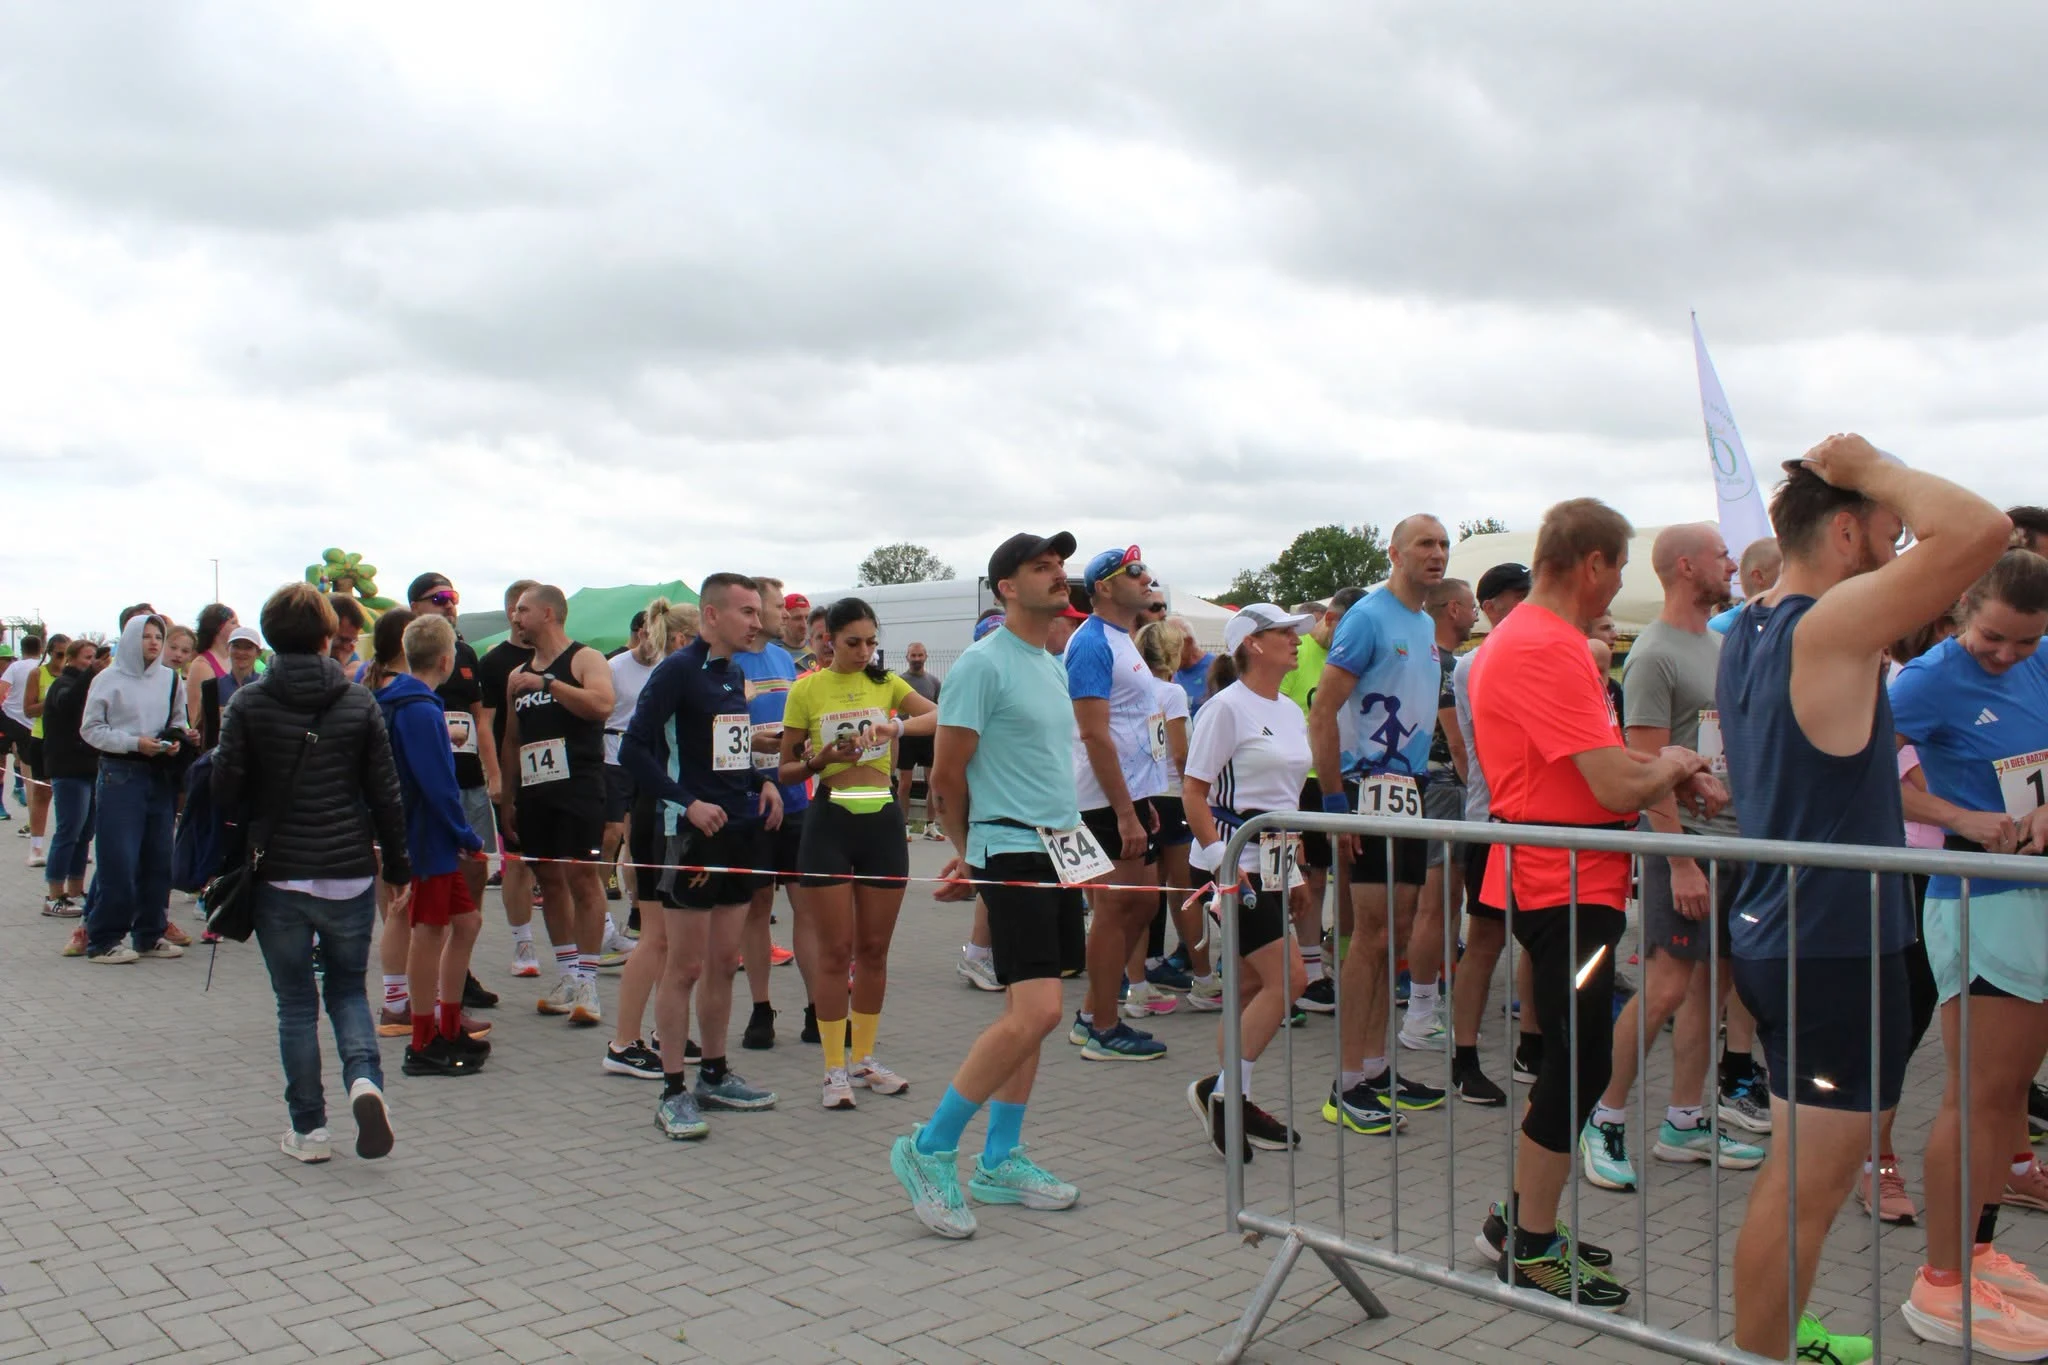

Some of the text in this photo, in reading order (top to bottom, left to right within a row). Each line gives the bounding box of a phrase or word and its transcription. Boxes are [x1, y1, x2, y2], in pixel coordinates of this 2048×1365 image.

[515, 691, 557, 711] OAKLE
[729, 726, 749, 754] 33
[528, 748, 555, 773] 14
[1368, 784, 1417, 816] 155
[1048, 831, 1097, 869] 154
